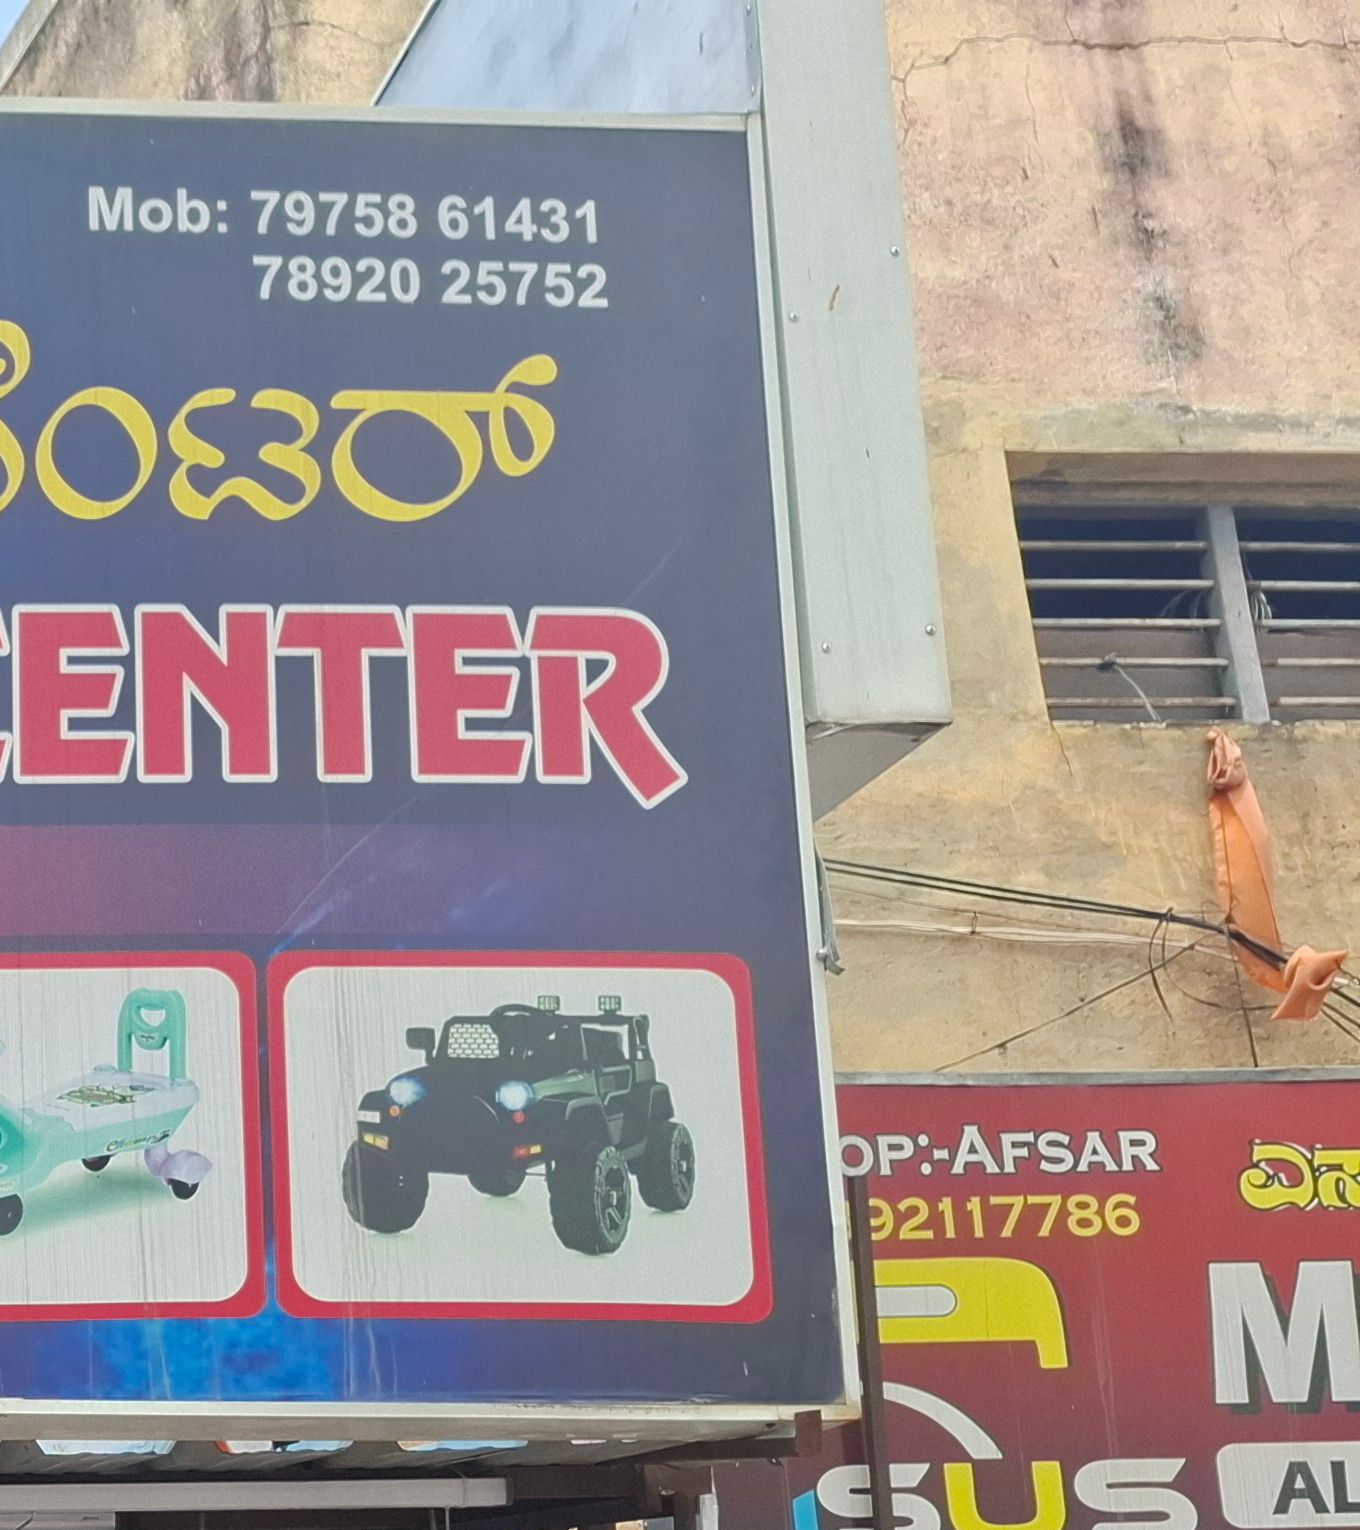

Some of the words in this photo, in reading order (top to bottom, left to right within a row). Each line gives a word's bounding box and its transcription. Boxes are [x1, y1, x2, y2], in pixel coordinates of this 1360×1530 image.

[88, 185, 228, 235] Mob:
[250, 189, 418, 239] 79758
[437, 194, 599, 244] 61431
[252, 254, 421, 304] 78920
[440, 258, 609, 309] 25752
[846, 1193, 1141, 1241] 92117786
